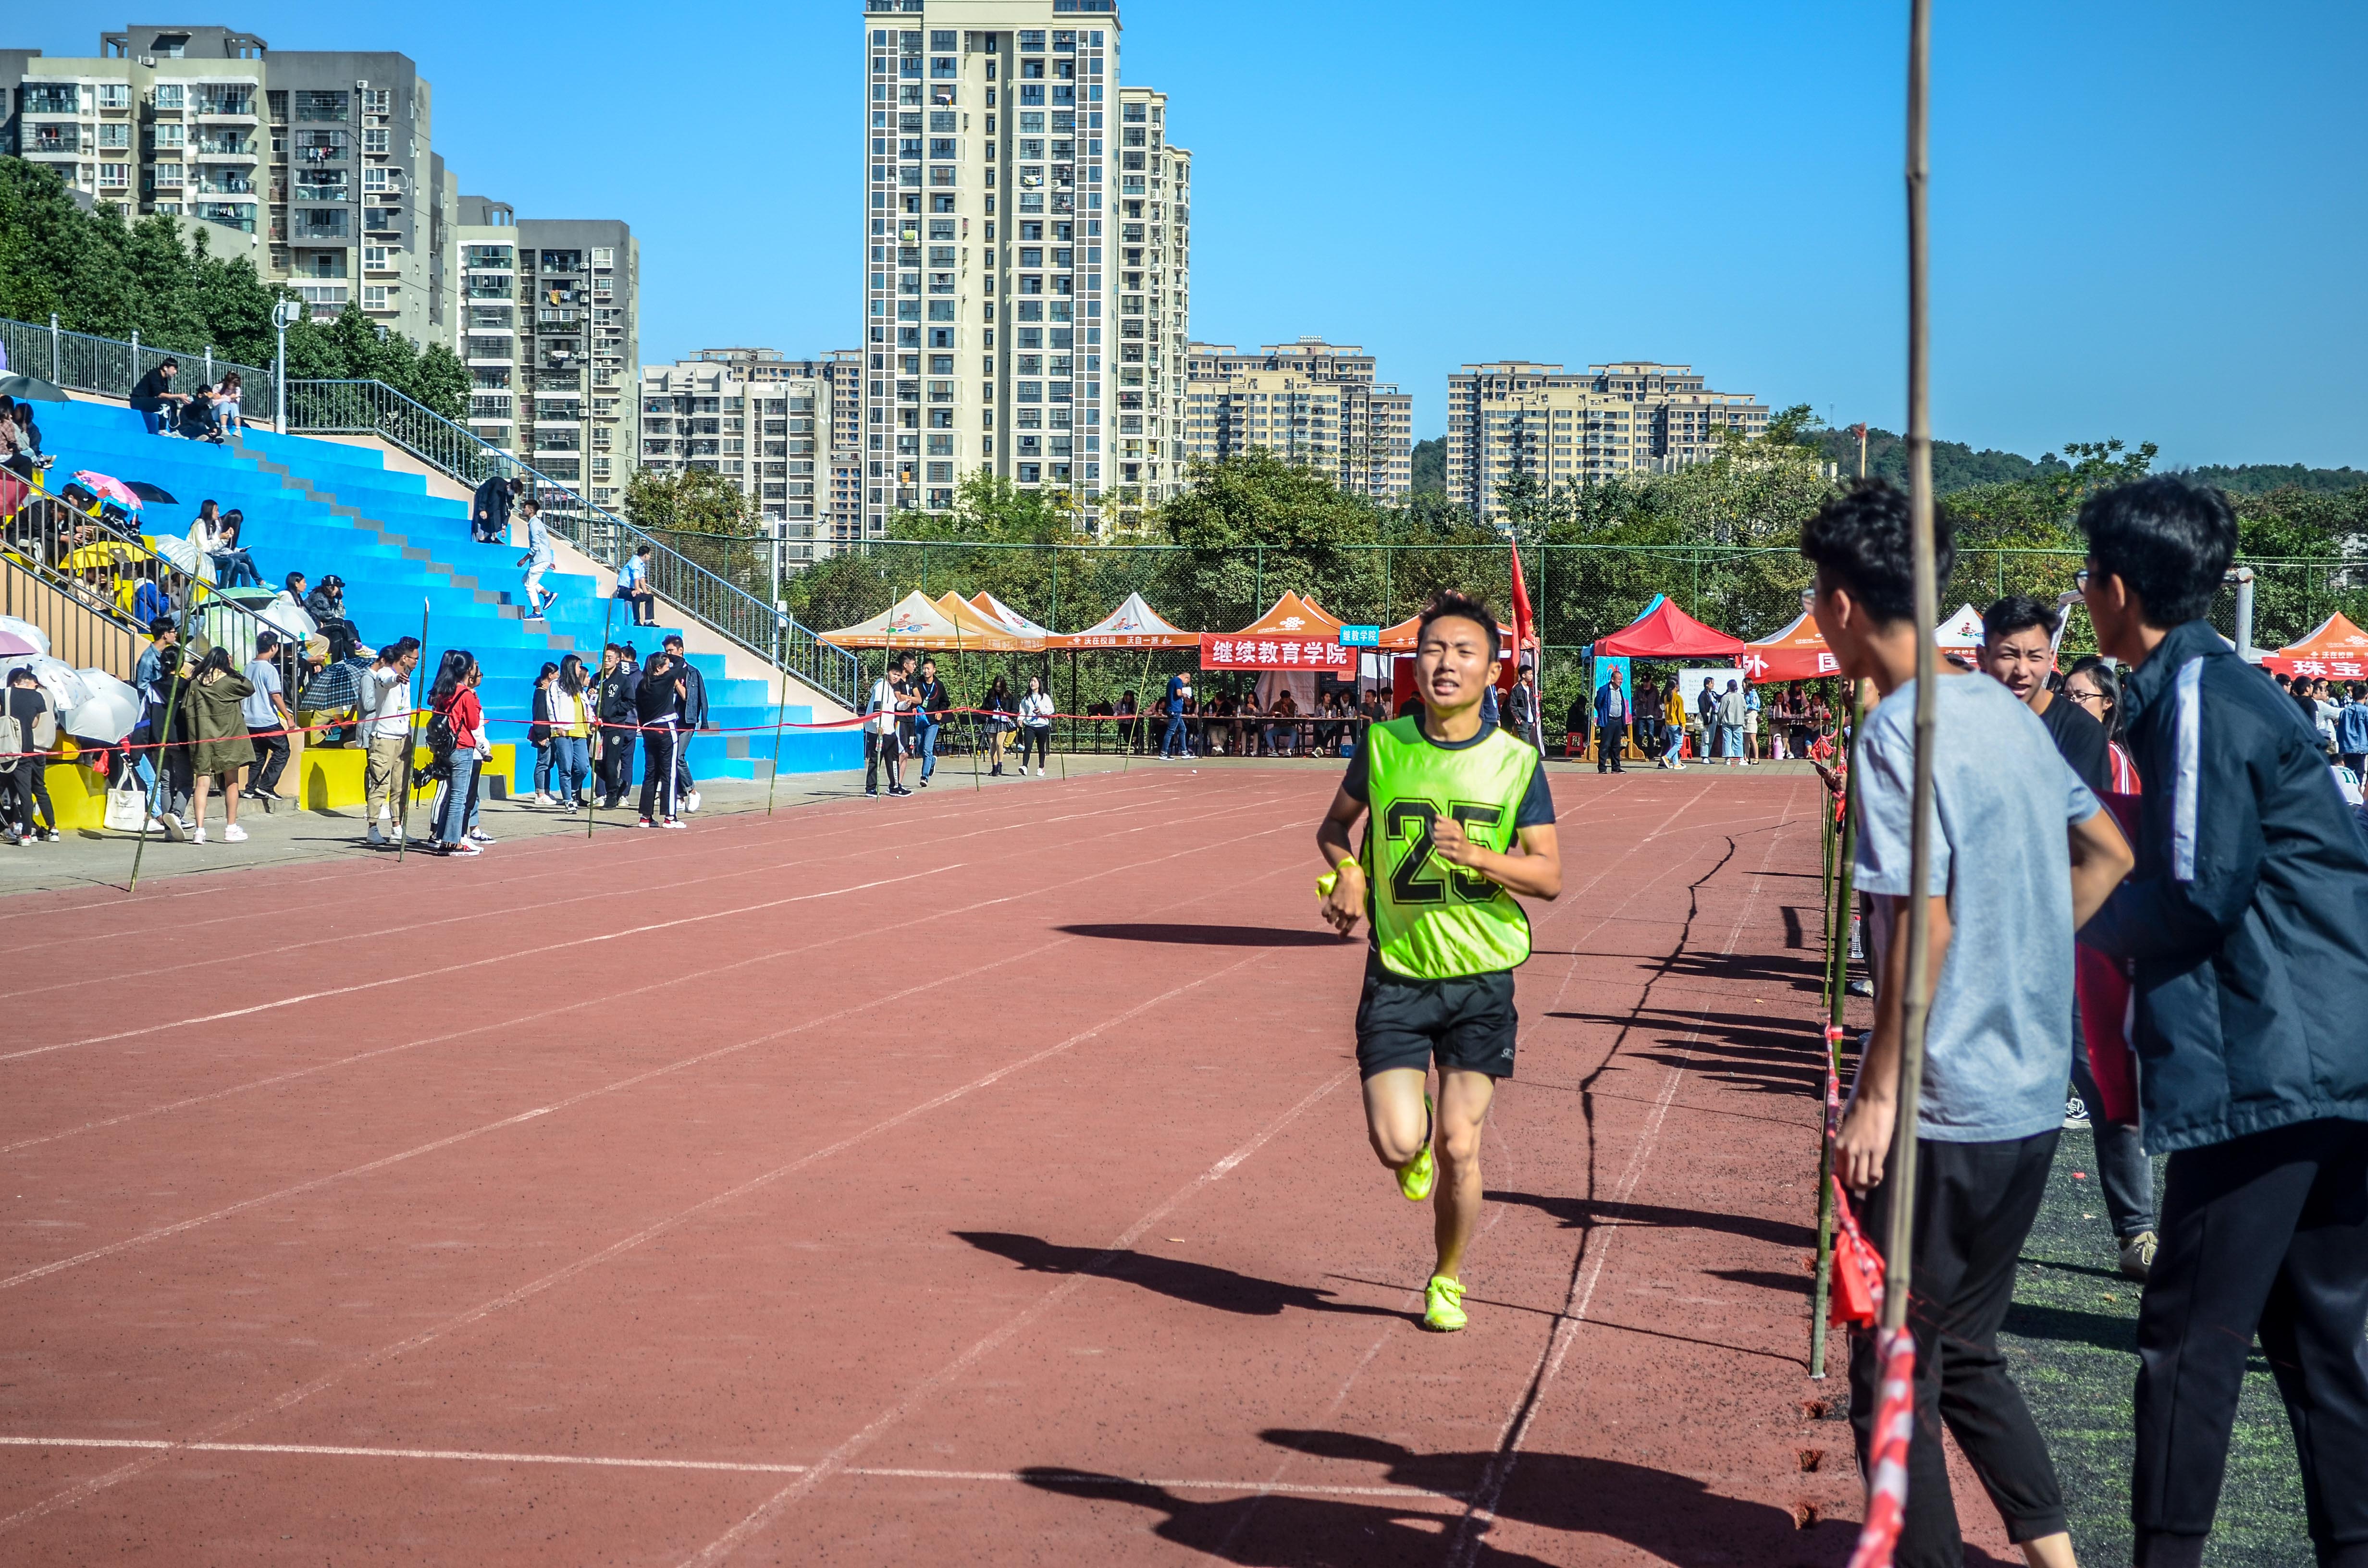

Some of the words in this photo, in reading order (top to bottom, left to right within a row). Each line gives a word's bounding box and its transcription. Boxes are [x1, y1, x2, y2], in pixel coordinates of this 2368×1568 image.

[1084, 636, 1116, 645] 沃在校园
[1127, 636, 1159, 645] 沃自一派
[1343, 630, 1376, 641] 继教学院
[906, 638, 946, 647] 沃自一派
[1212, 640, 1347, 664] 继续教育学院
[2292, 661, 2364, 676] 珠宝
[2342, 772, 2356, 784] 11
[1384, 797, 1506, 905] 25
